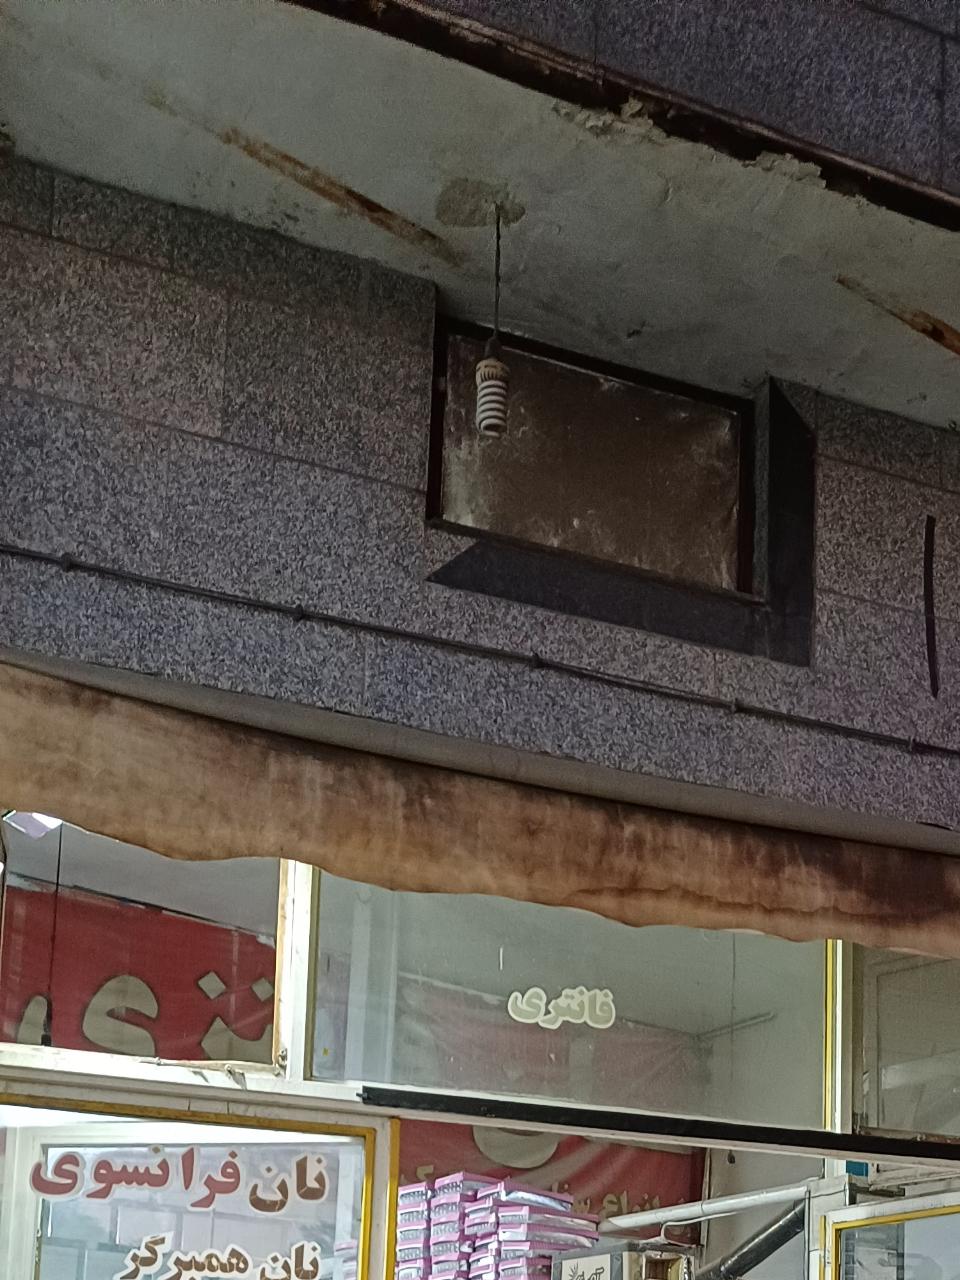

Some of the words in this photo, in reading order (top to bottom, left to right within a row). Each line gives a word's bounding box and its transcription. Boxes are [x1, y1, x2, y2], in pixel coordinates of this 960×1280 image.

[508, 986, 615, 1029] فانتزی
[29, 1146, 243, 1210] فرانسوی
[247, 1152, 329, 1214] نان
